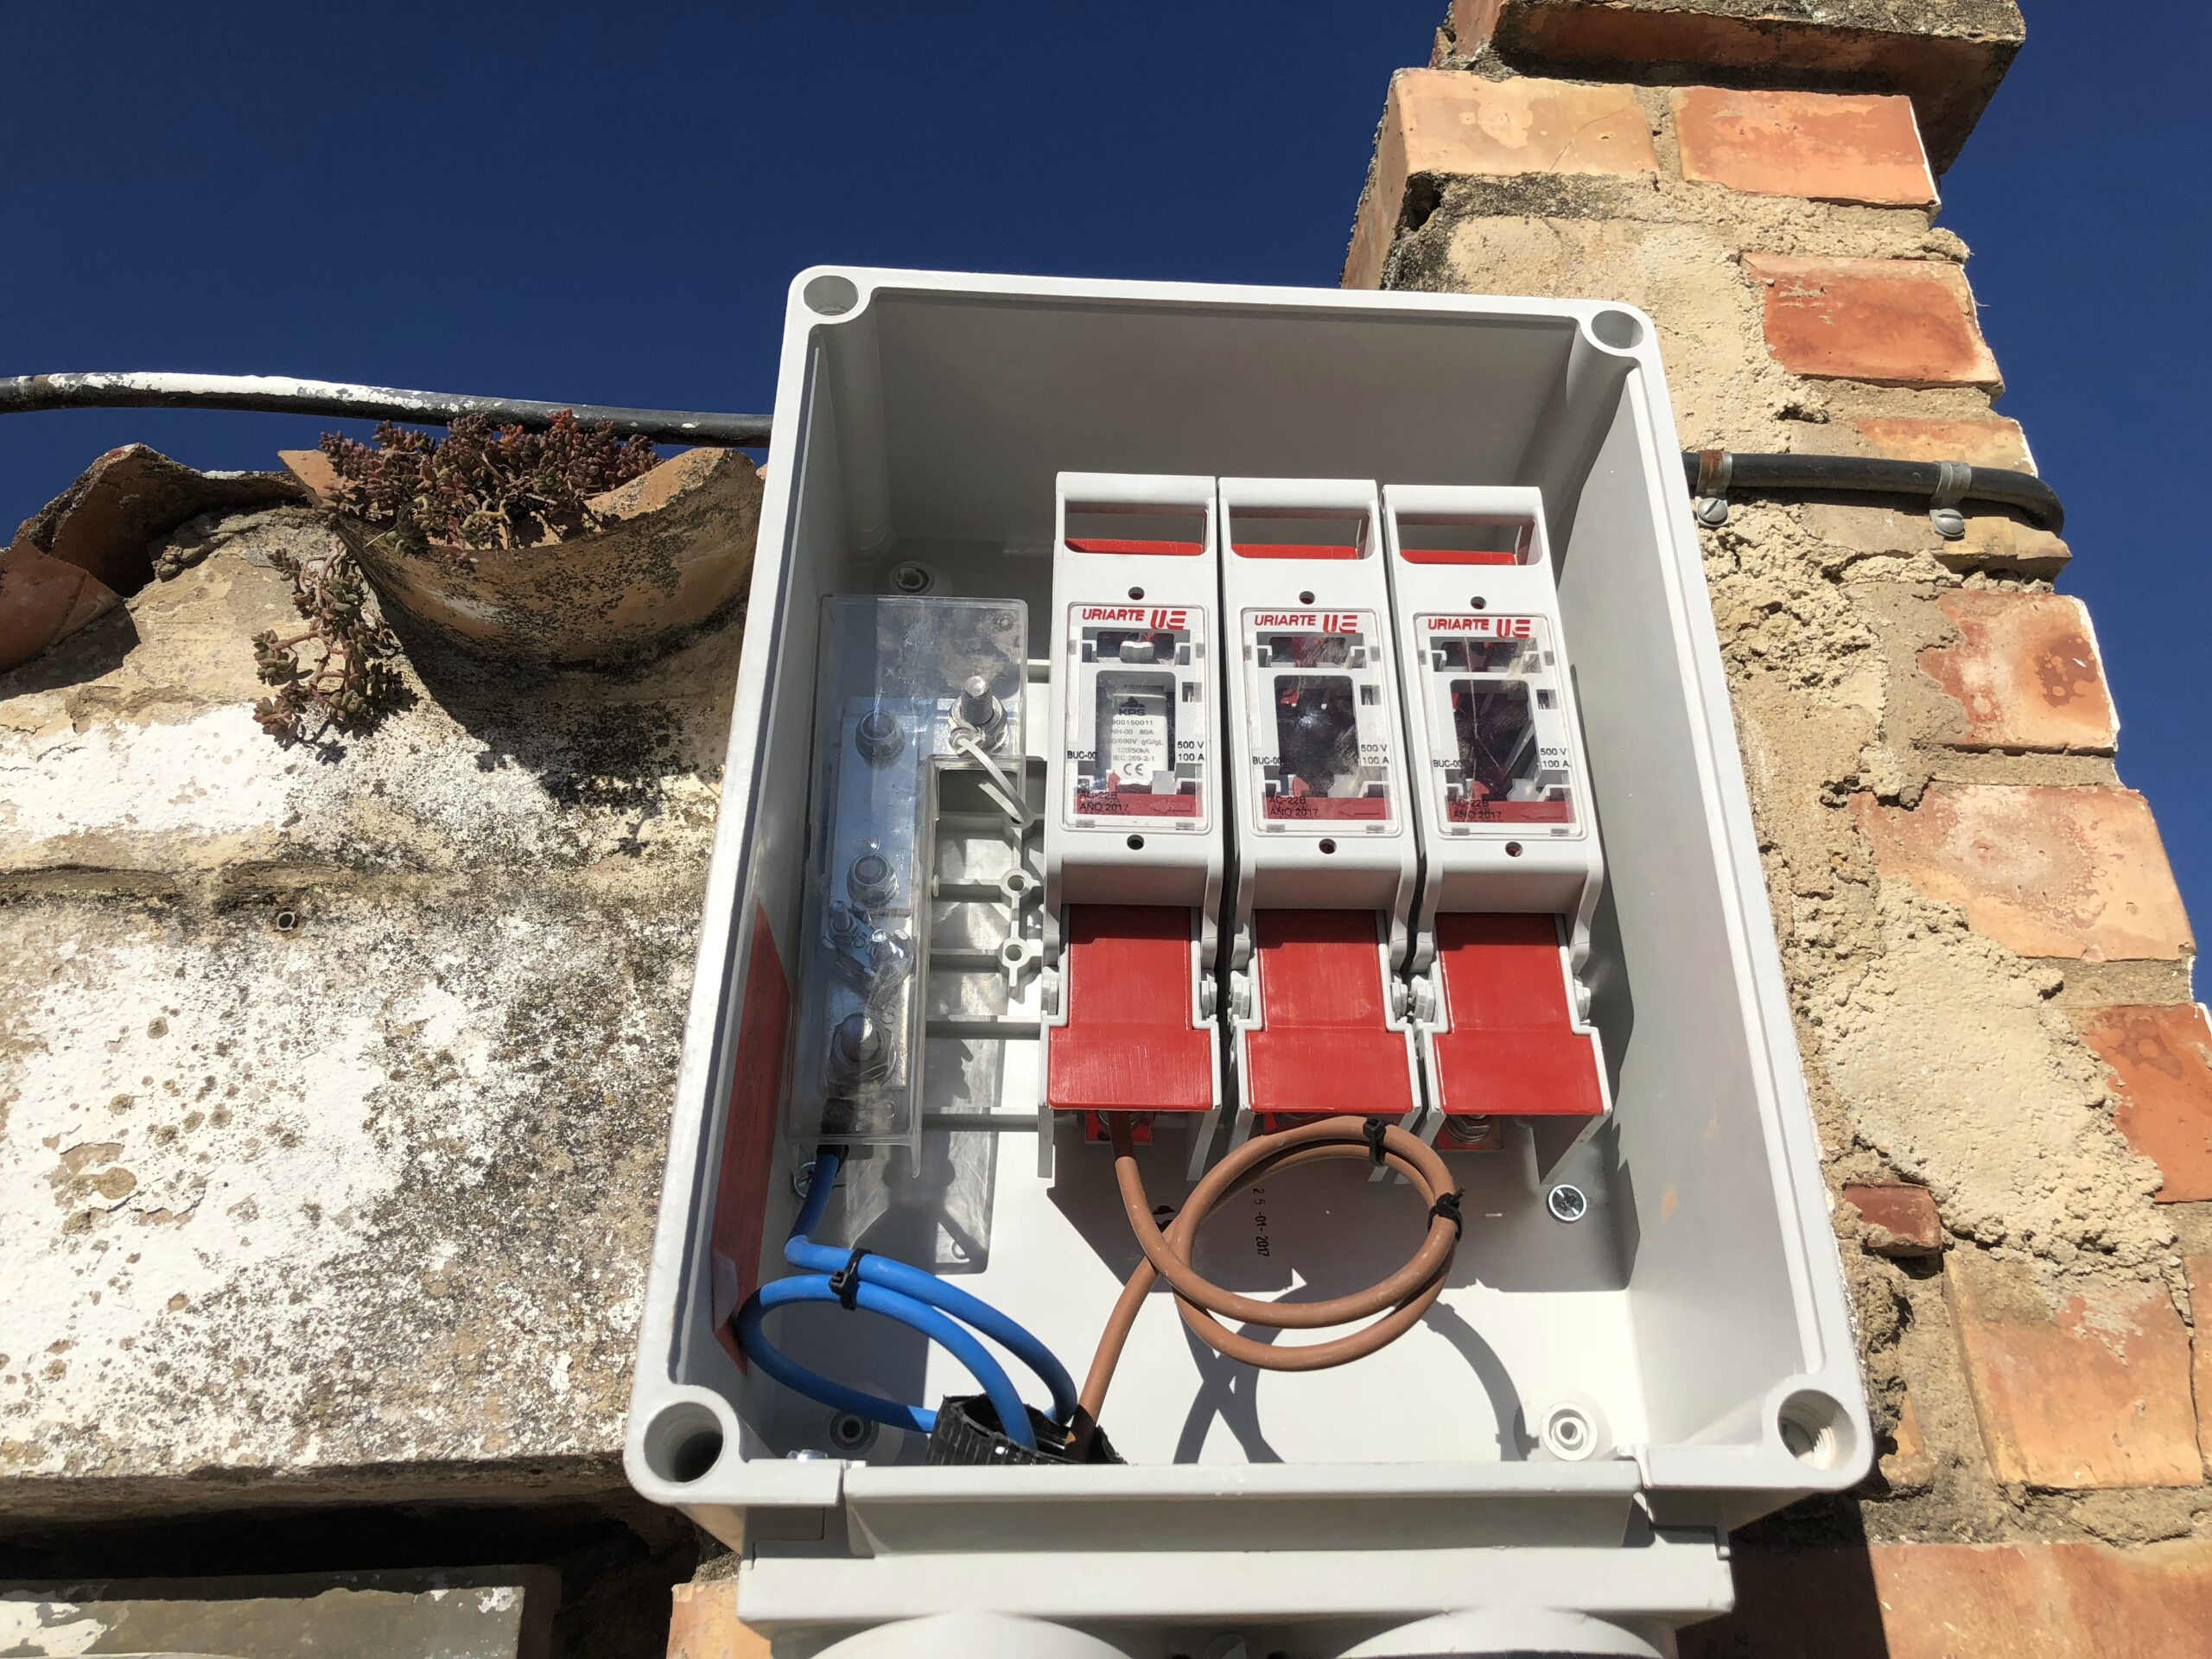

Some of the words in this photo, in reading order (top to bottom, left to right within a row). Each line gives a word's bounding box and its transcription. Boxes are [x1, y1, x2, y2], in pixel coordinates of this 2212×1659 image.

[1082, 608, 1145, 621] URIARTE
[1254, 614, 1316, 626] URIARTE
[1427, 618, 1490, 631] URIARTE
[1177, 741, 1195, 749] 500
[1540, 747, 1557, 756] 500
[1178, 753, 1195, 761] 100
[1362, 756, 1380, 765] 100
[1268, 796, 1306, 804] AC-22B
[1295, 808, 1319, 817] 2017
